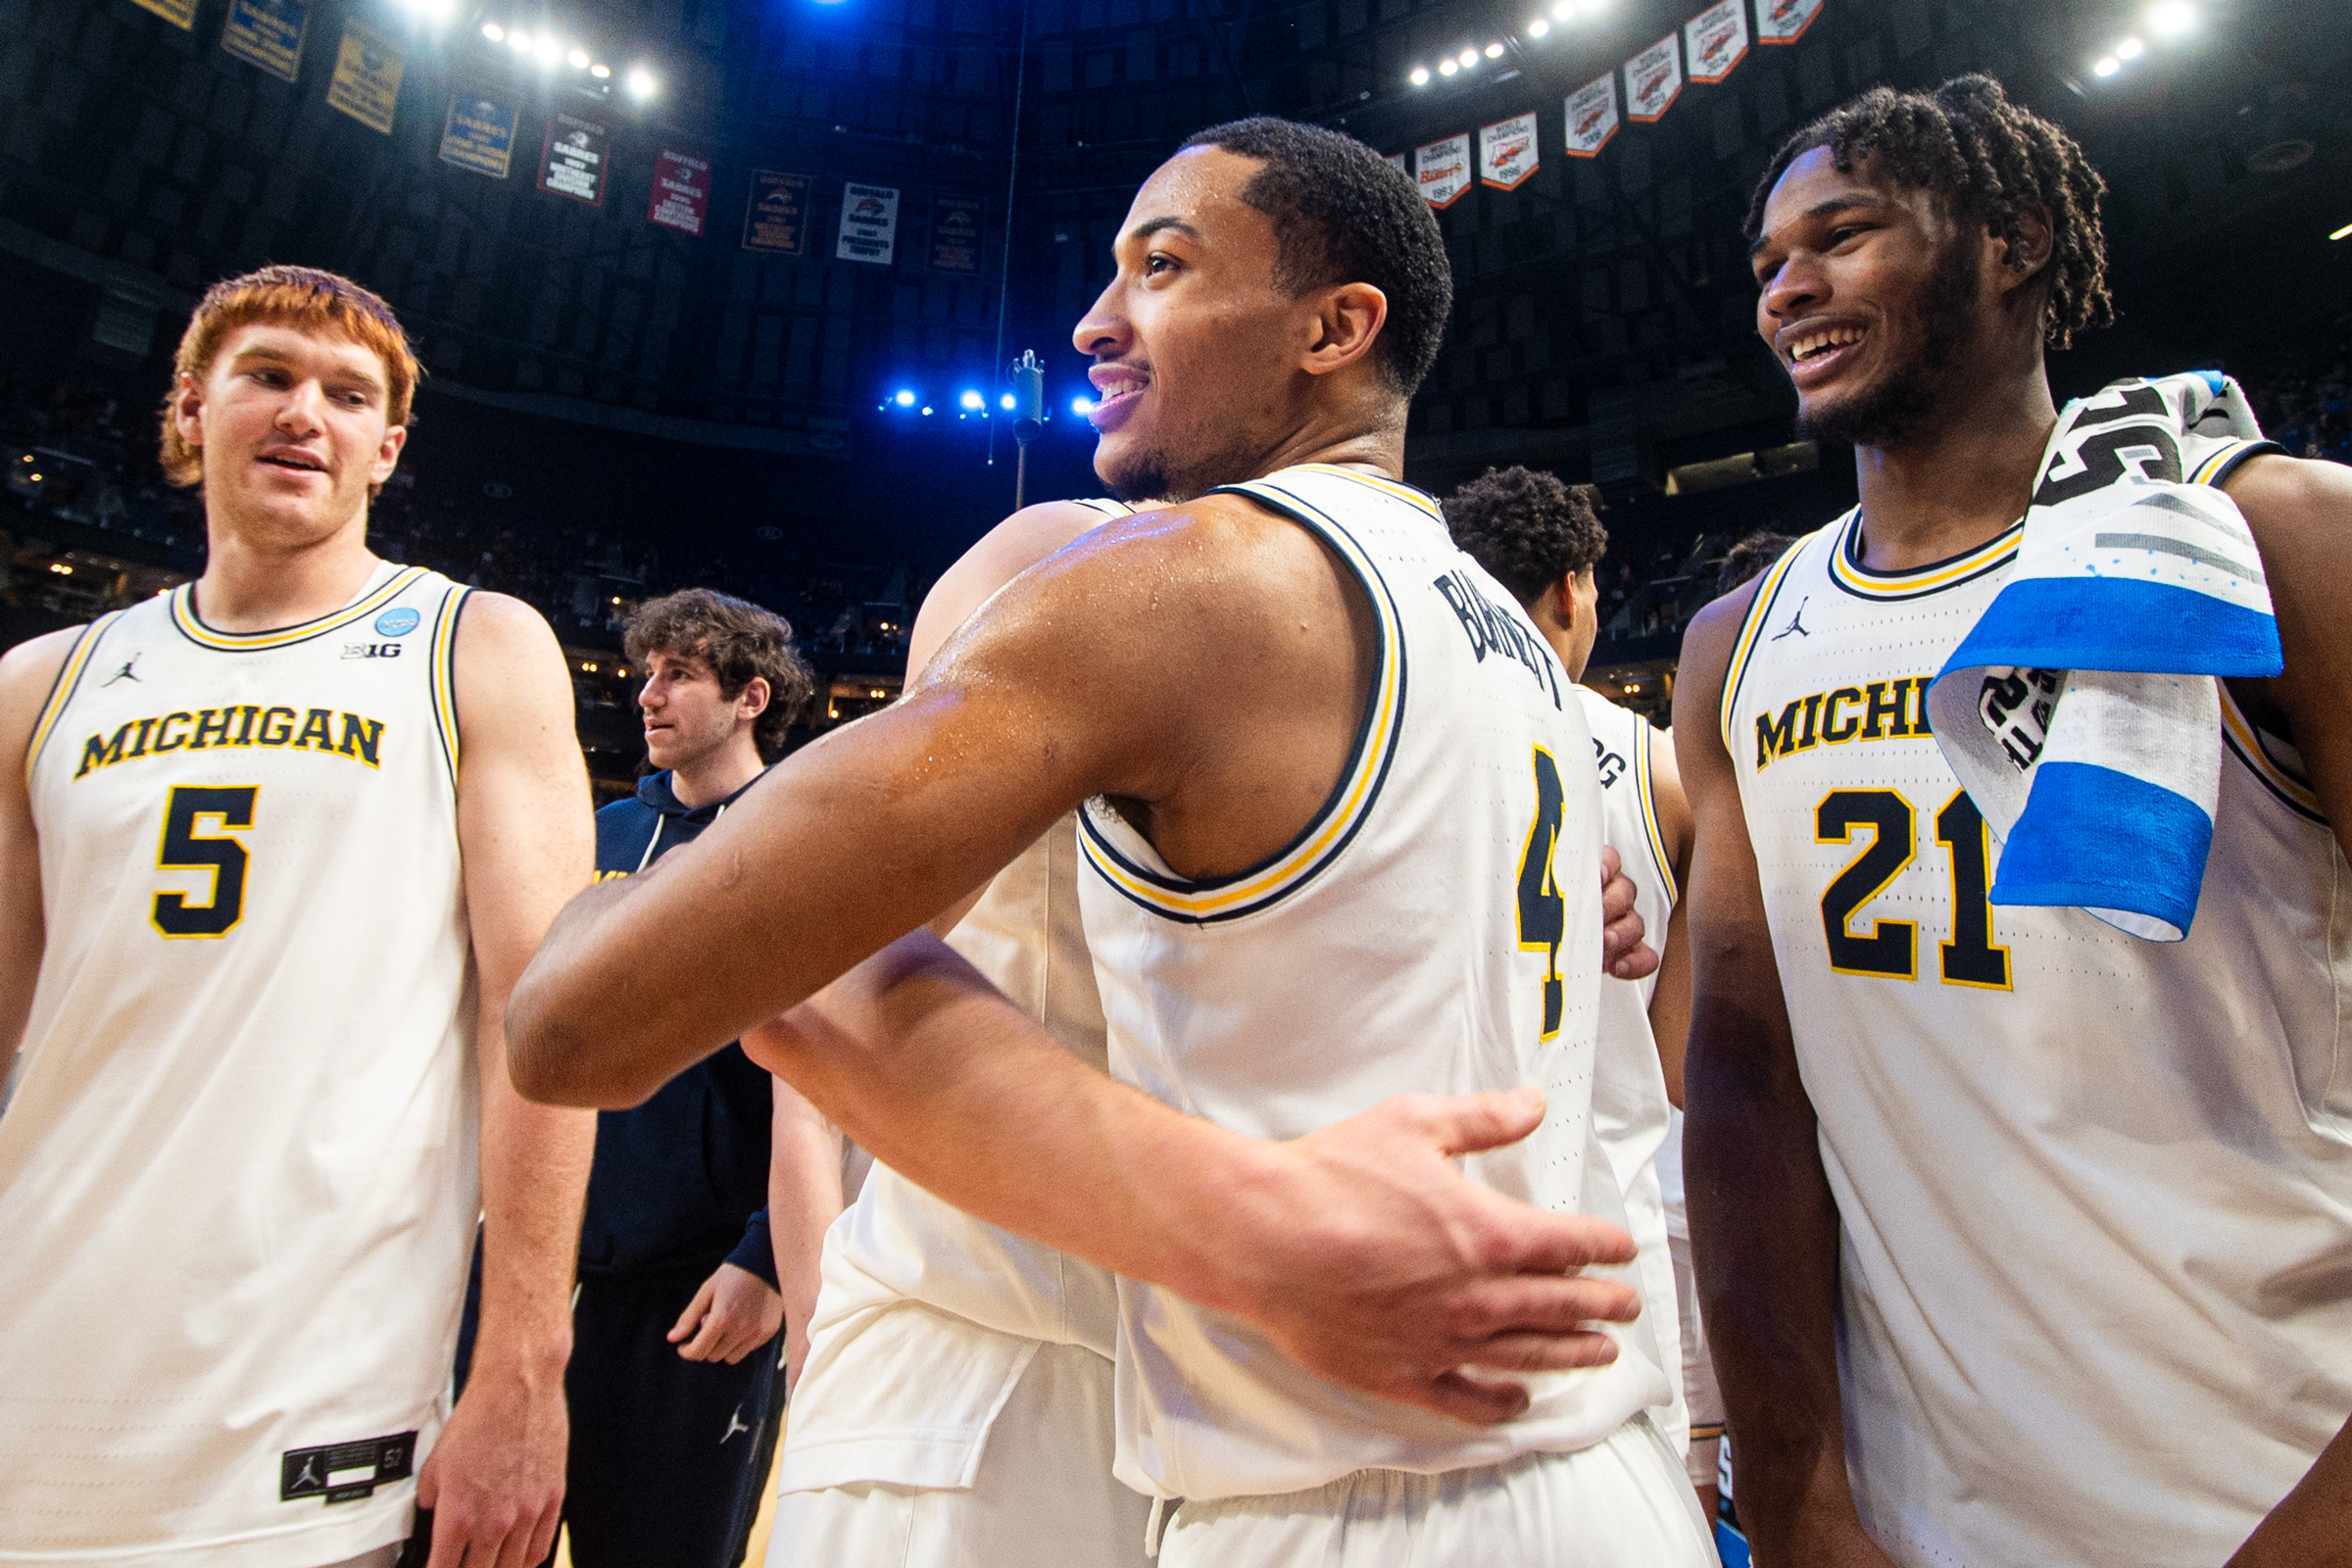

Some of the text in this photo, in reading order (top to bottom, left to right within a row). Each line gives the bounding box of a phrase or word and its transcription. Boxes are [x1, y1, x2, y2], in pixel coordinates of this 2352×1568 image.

[74, 704, 385, 783] MICHIGAN
[149, 785, 261, 939] 5
[1515, 740, 1566, 1044] 4
[1814, 786, 2013, 992] 21
